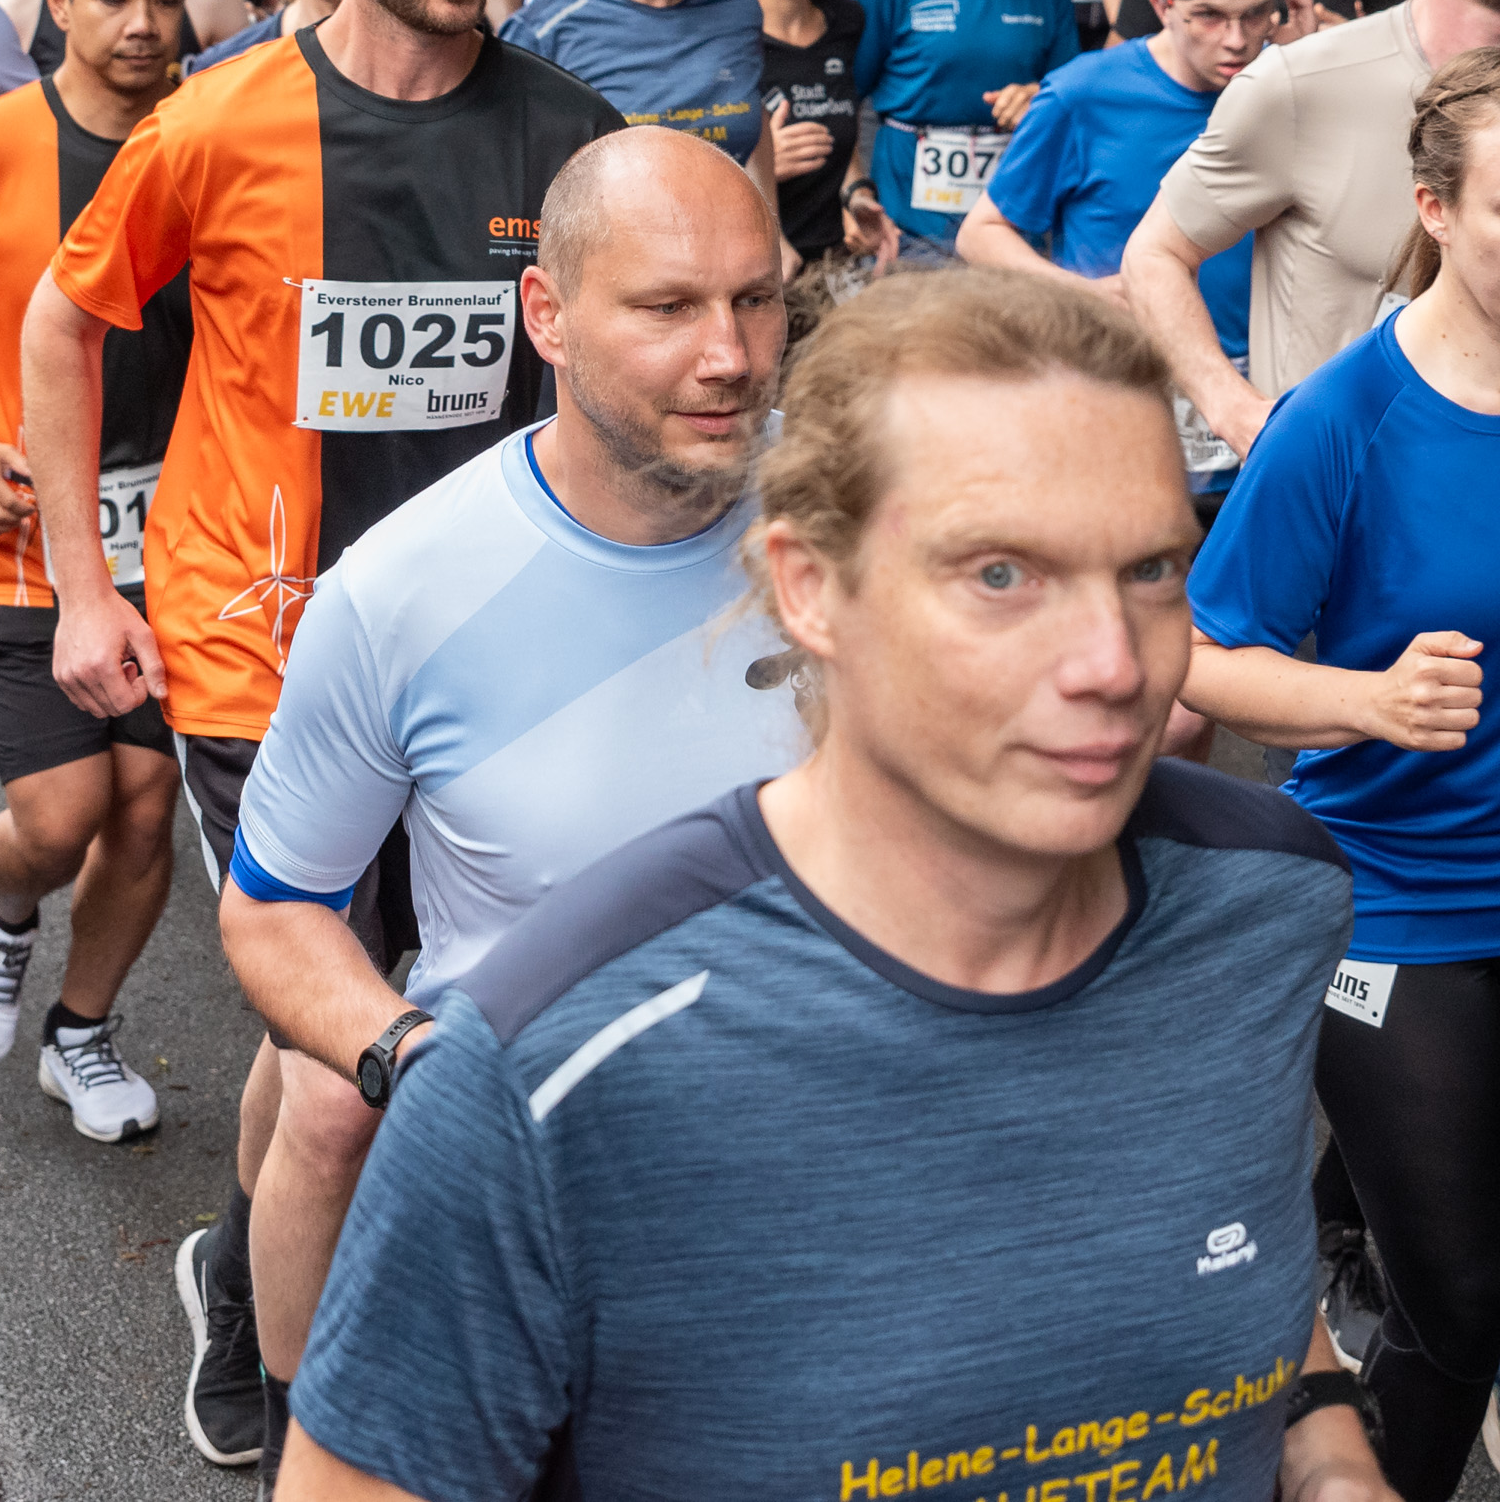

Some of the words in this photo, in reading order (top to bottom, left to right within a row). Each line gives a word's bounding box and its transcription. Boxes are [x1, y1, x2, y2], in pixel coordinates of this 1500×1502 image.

[316, 293, 403, 307] Everstener
[408, 293, 502, 307] Brunnenlauf
[311, 312, 506, 370] 1025
[388, 374, 425, 386] Nico
[318, 390, 397, 418] EWE
[427, 388, 489, 413] bruns
[1330, 971, 1371, 1002] uns
